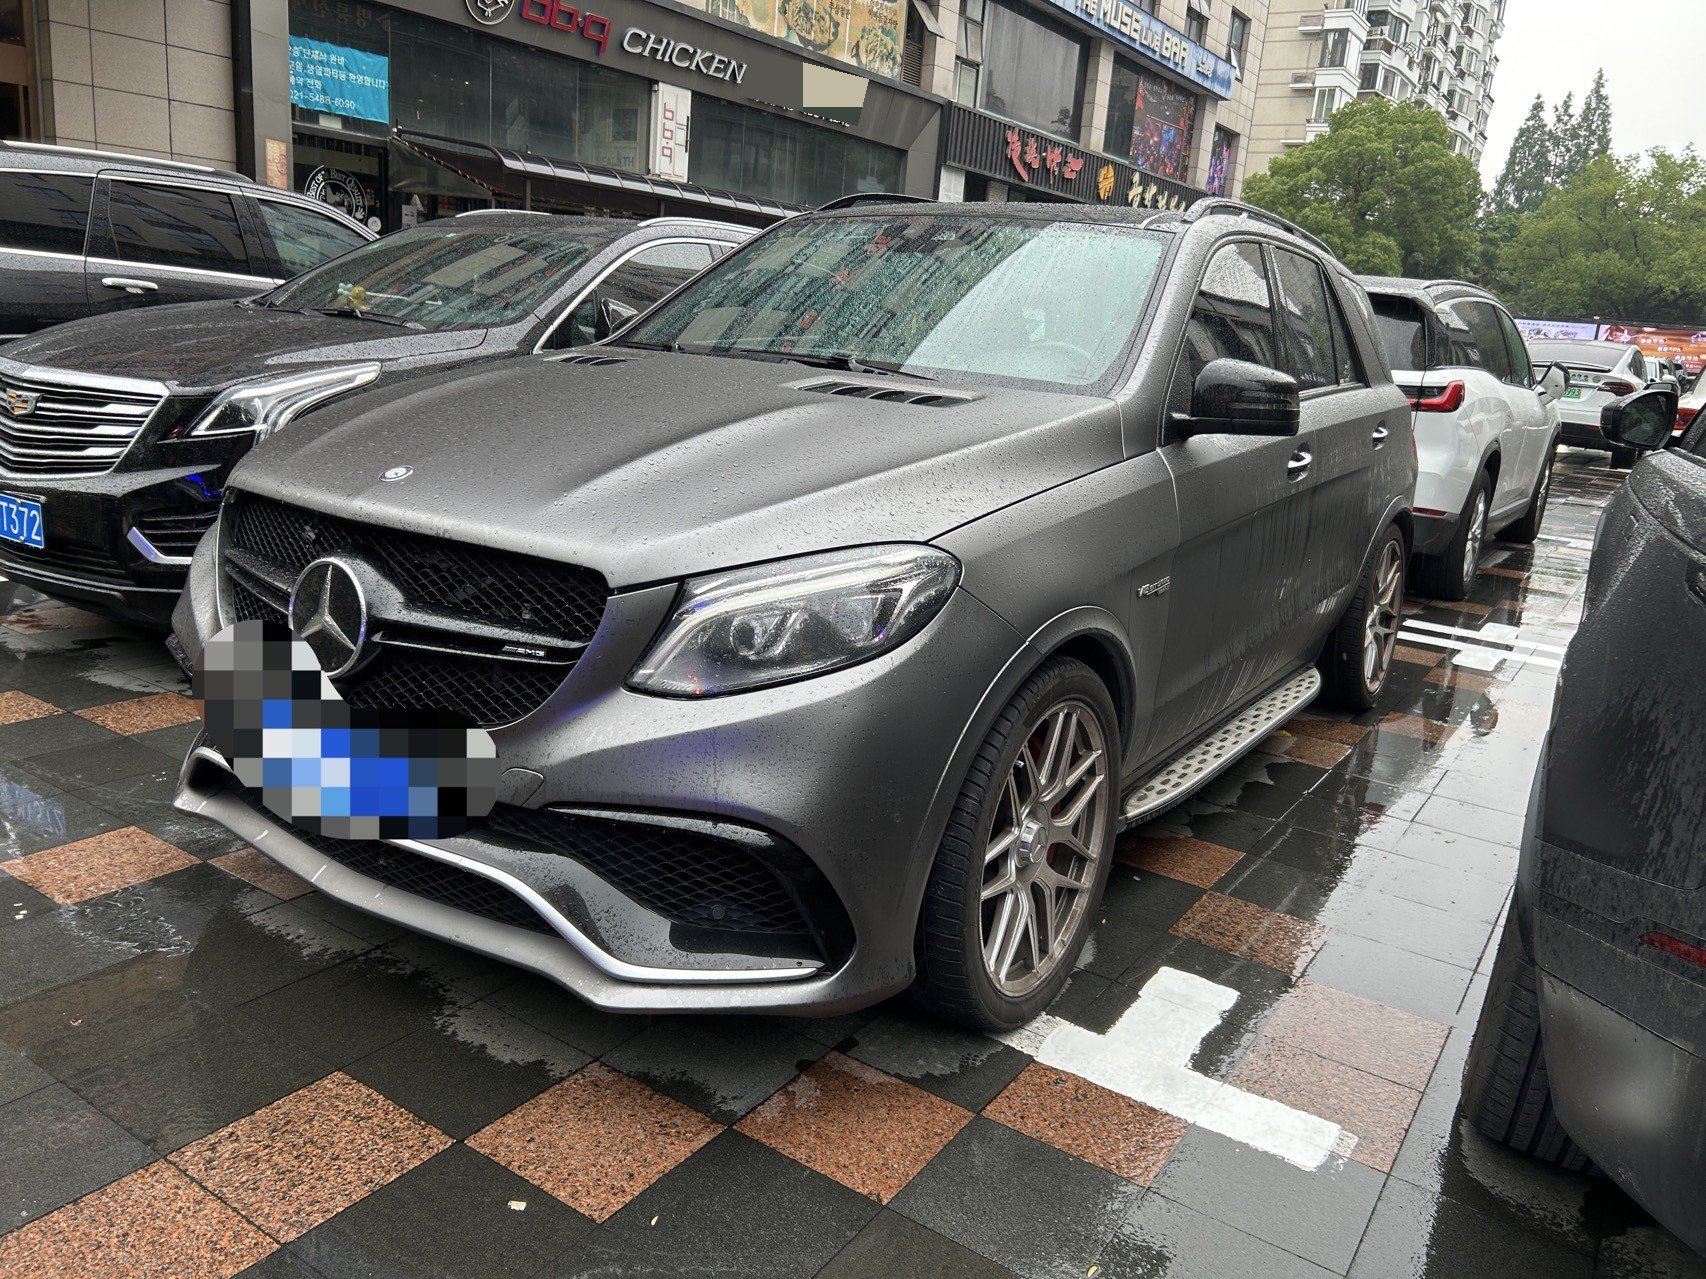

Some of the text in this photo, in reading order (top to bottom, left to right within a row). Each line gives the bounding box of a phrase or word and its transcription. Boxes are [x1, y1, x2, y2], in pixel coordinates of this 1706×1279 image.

[1098, 0, 1143, 40] MUSE
[1160, 30, 1189, 69] BAR
[329, 53, 345, 66] 완비
[622, 27, 748, 84] CHICKEN
[306, 77, 322, 90] 전화
[330, 168, 346, 182] BEST
[346, 177, 363, 208] QUALITY
